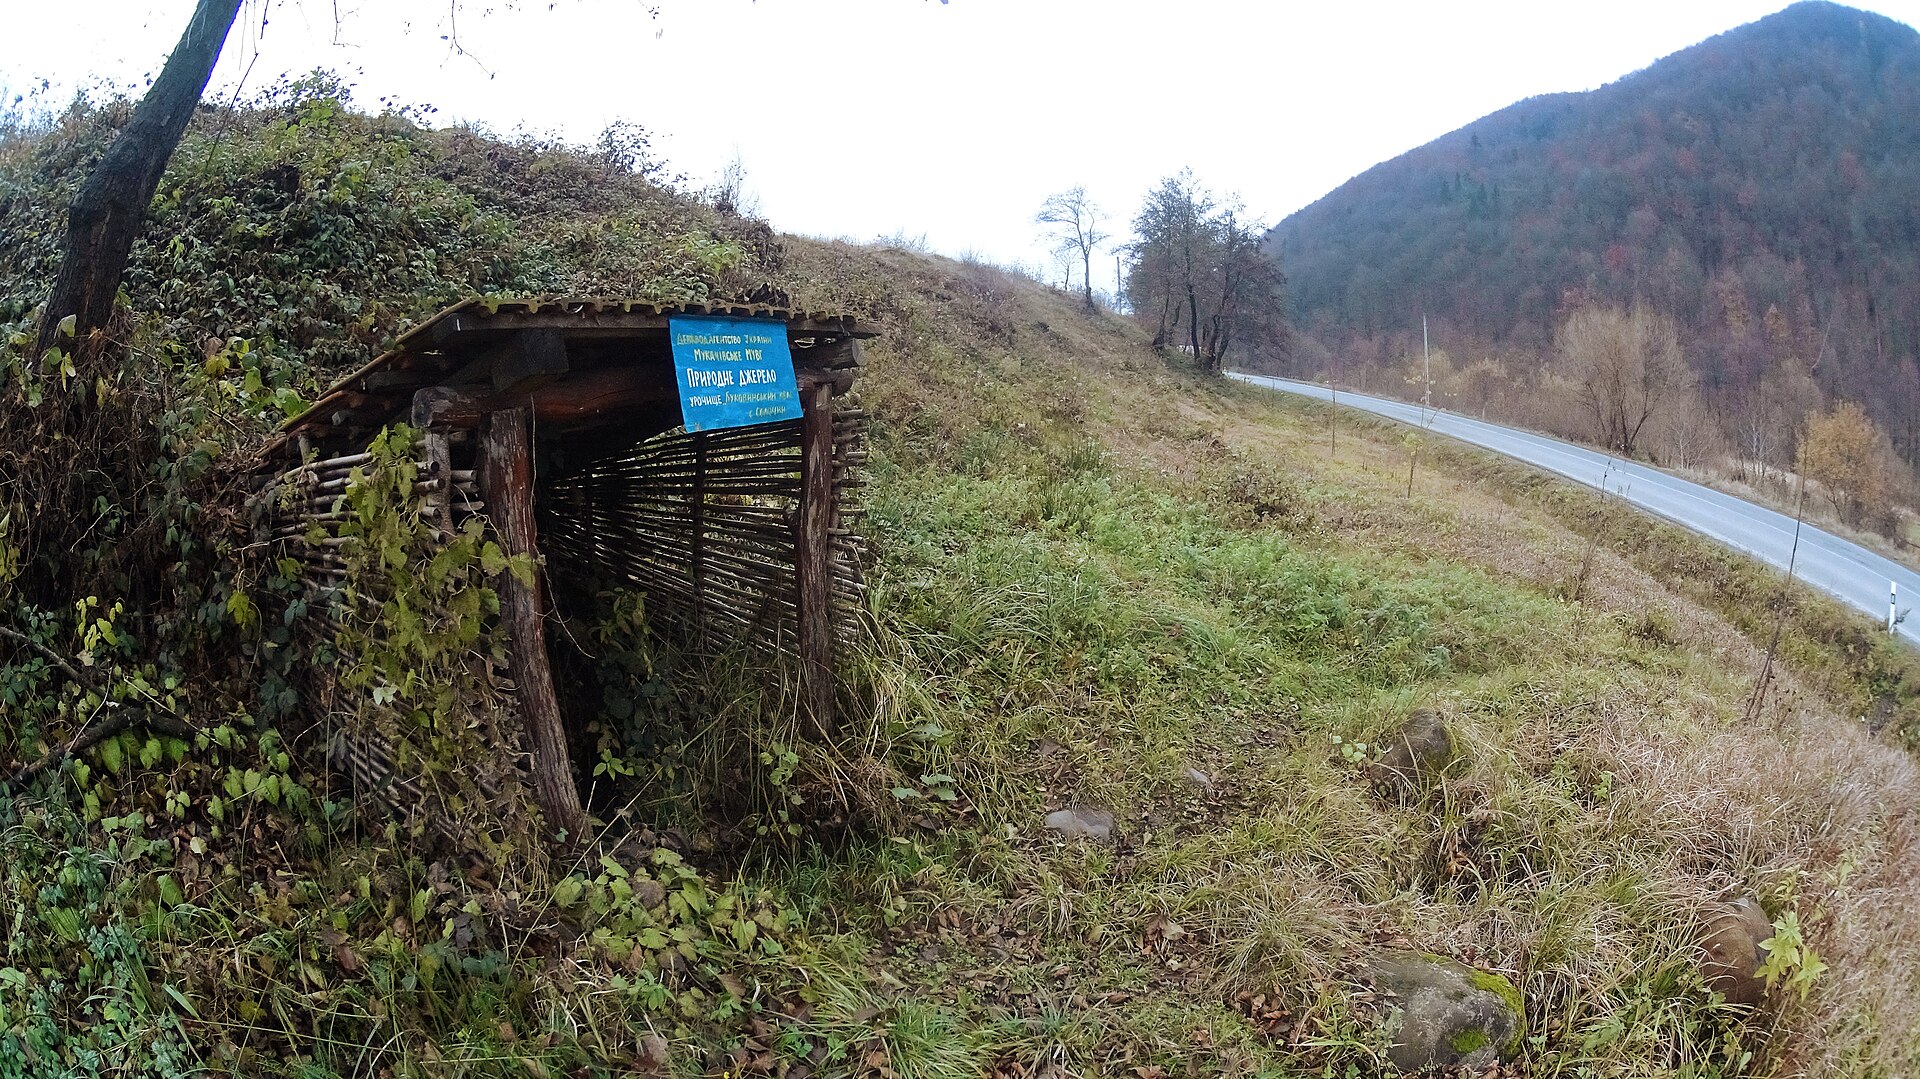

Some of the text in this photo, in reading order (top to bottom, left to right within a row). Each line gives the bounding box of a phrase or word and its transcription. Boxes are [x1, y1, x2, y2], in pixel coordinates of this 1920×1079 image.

[686, 367, 777, 388] ПРИРОДНЕ ДЖЕРЕЛО
[689, 394, 722, 407] УРОЧИЩЕ
